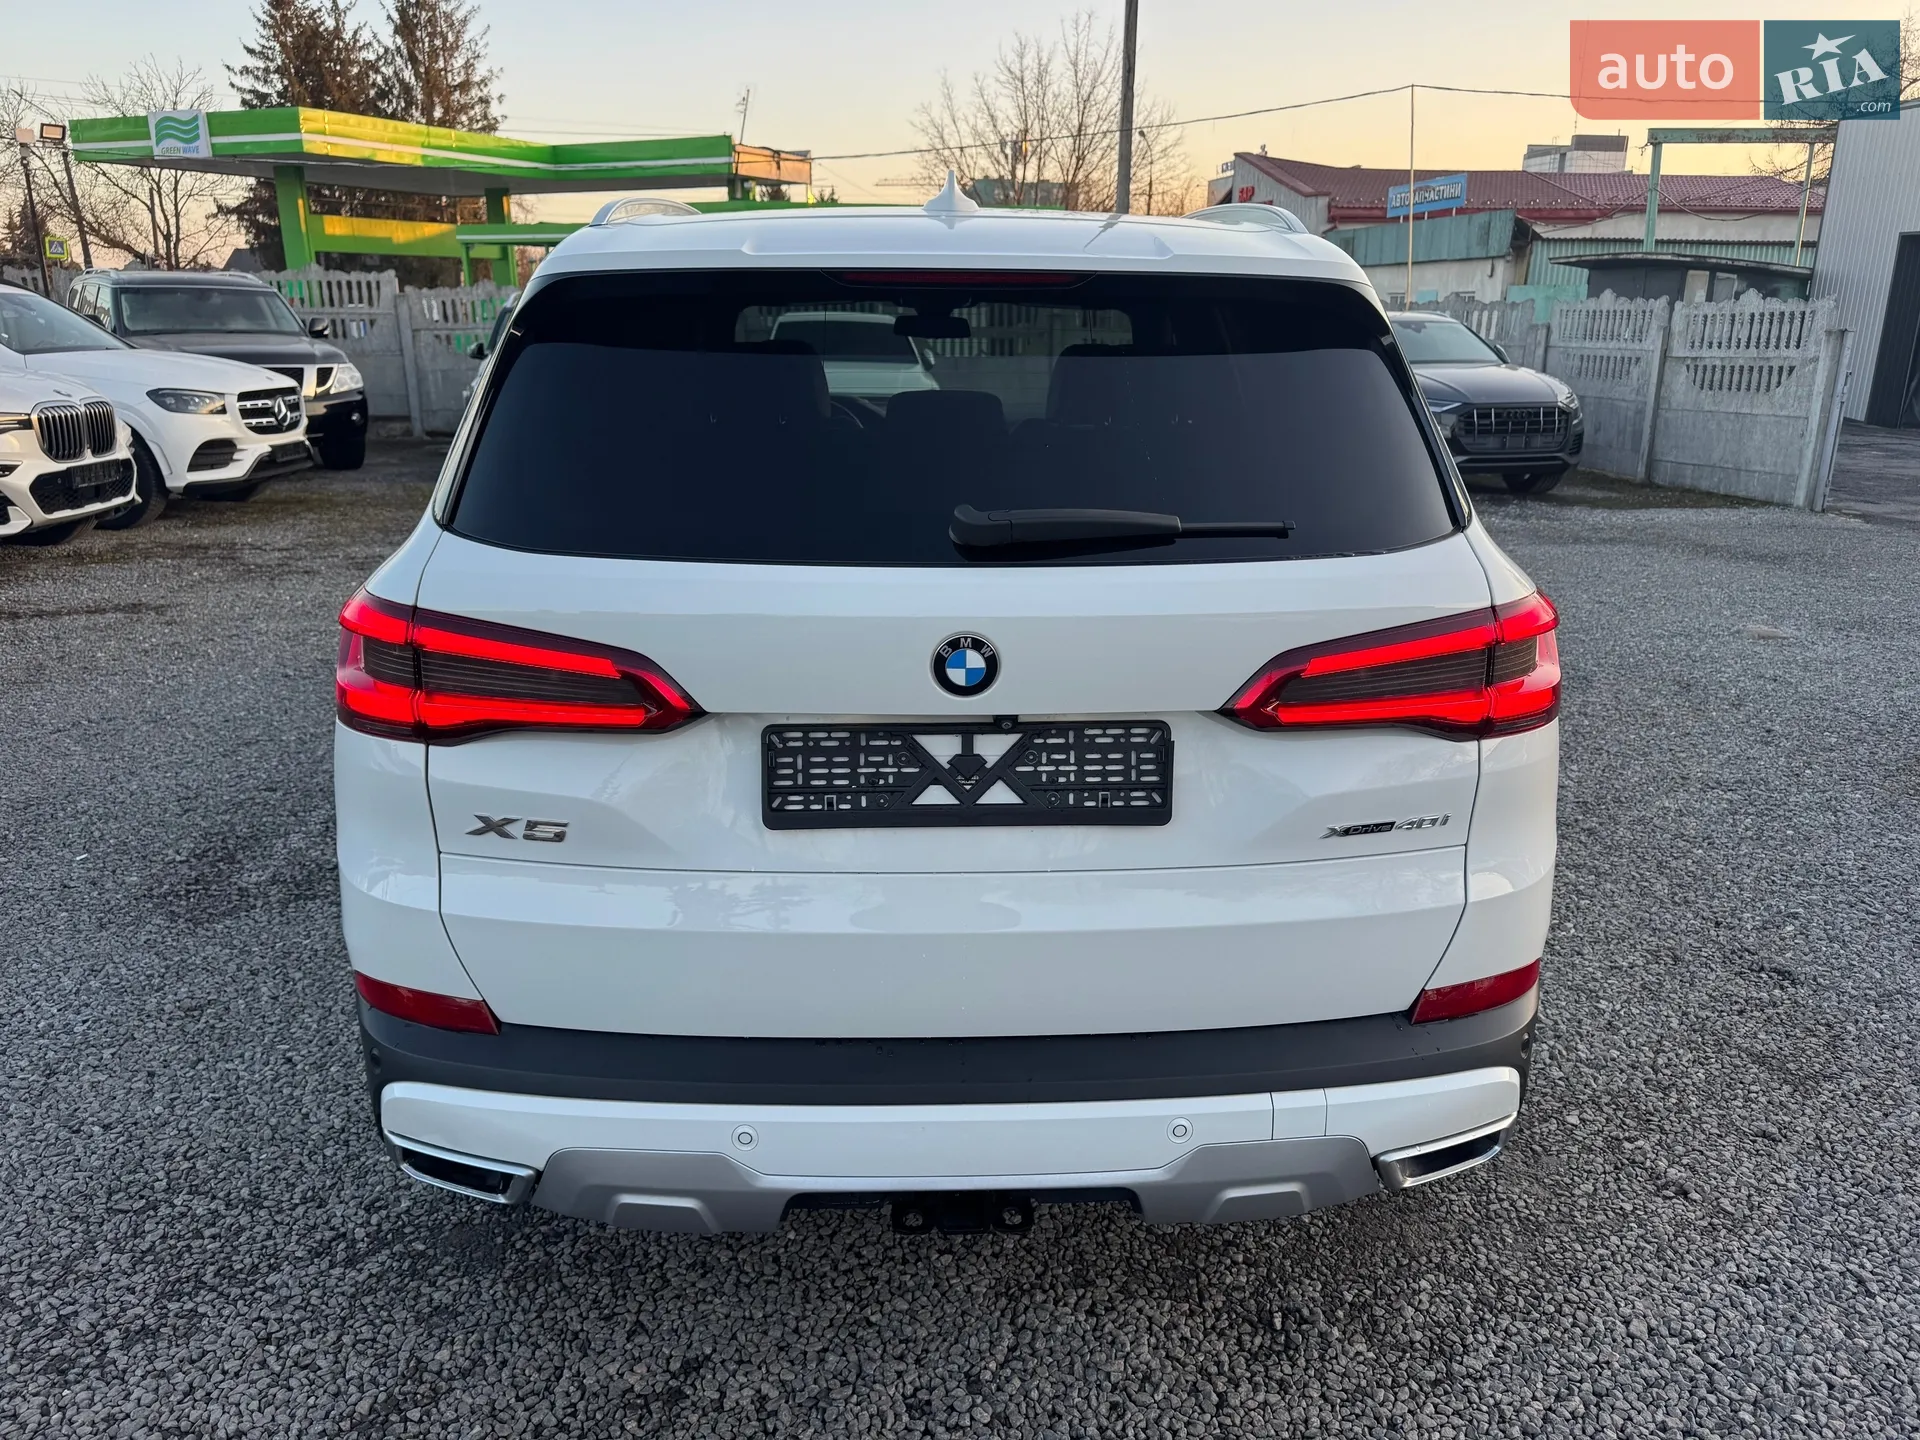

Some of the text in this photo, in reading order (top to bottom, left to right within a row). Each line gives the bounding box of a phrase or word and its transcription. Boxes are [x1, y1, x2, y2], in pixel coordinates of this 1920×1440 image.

[160, 145, 200, 155] GREEN WAVE
[1391, 182, 1463, 209] АВТОАПЧАСТИНИ
[939, 637, 994, 659] BMW
[464, 812, 570, 843] X5
